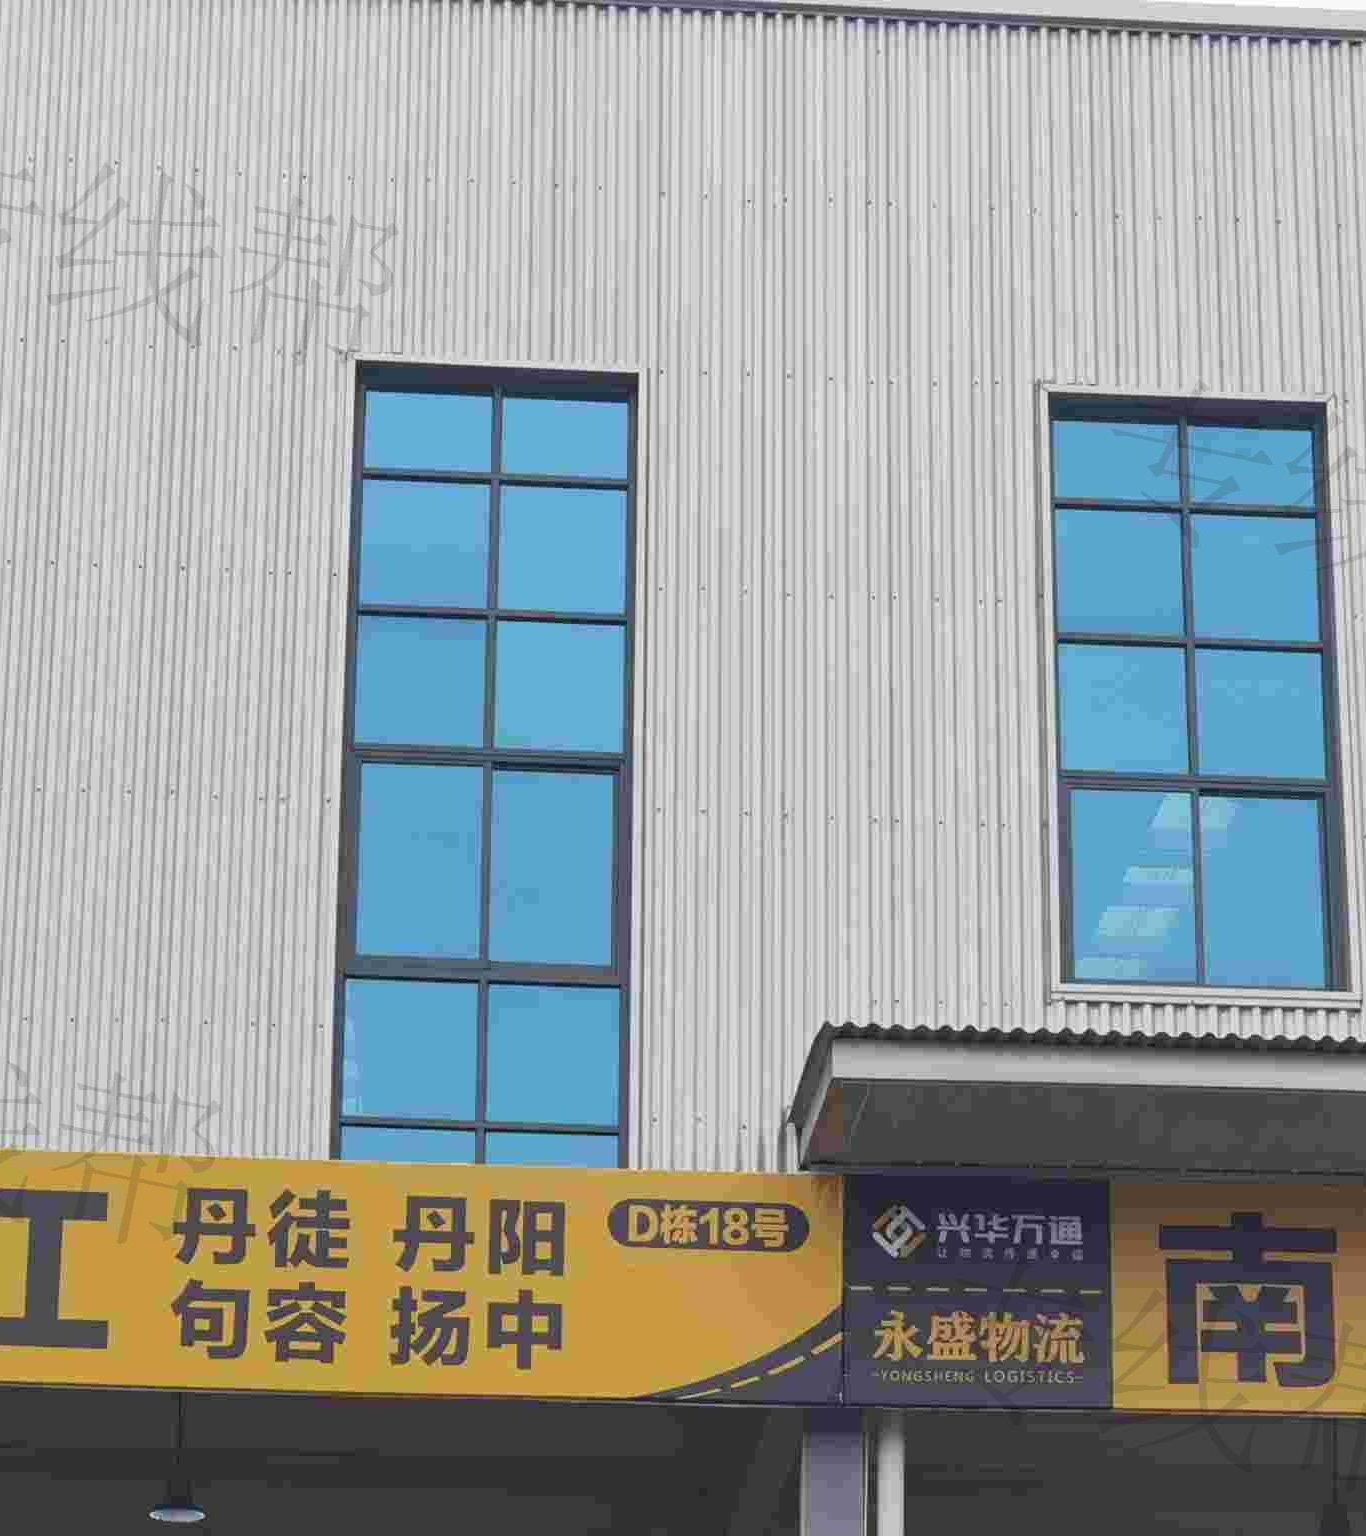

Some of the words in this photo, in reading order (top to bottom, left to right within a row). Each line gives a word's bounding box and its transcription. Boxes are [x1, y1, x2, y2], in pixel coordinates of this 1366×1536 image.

[172, 1187, 351, 1269] 丹徒
[392, 1195, 566, 1277] 丹阳
[627, 1203, 790, 1248] D栋18号
[936, 1213, 1084, 1246] 兴华万通
[170, 1278, 347, 1365] 句容
[388, 1286, 564, 1370] 扬中
[872, 1309, 1085, 1364] 永盛物流
[881, 1370, 975, 1384] YONGSHENG
[984, 1370, 1075, 1385] LOGISTICS
